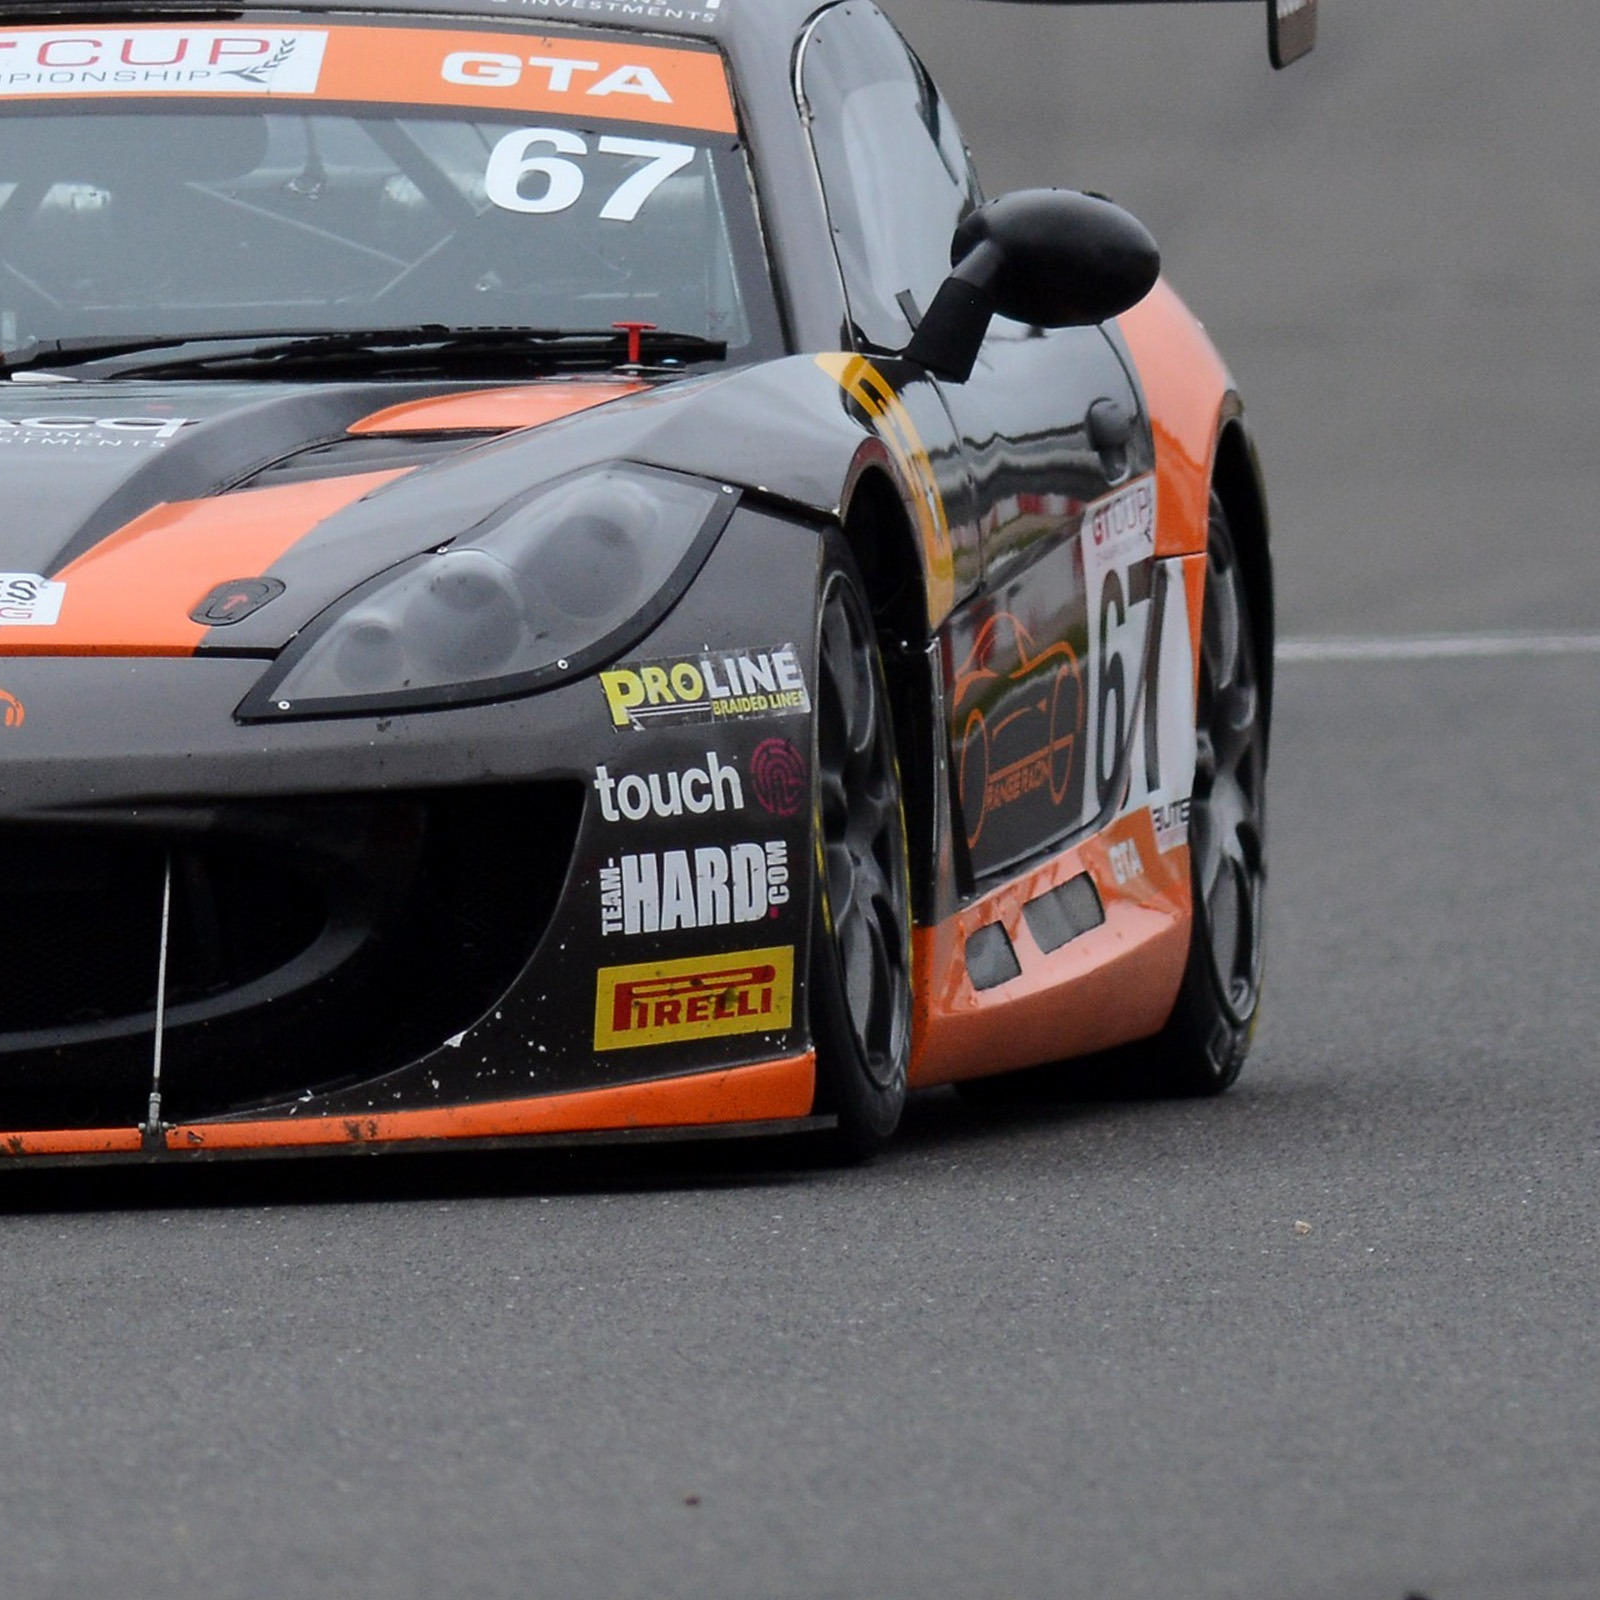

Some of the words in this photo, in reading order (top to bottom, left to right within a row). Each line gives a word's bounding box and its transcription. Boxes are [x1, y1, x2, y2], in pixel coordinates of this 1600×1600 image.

[37, 37, 270, 67] CUP
[440, 50, 674, 104] GTA
[483, 127, 696, 223] 67
[712, 695, 769, 716] BRAIDED
[770, 689, 806, 709] LINES
[1096, 560, 1169, 802] 67
[594, 751, 744, 822] touch
[621, 841, 768, 936] HARD
[612, 964, 776, 1033] PIRELLI
